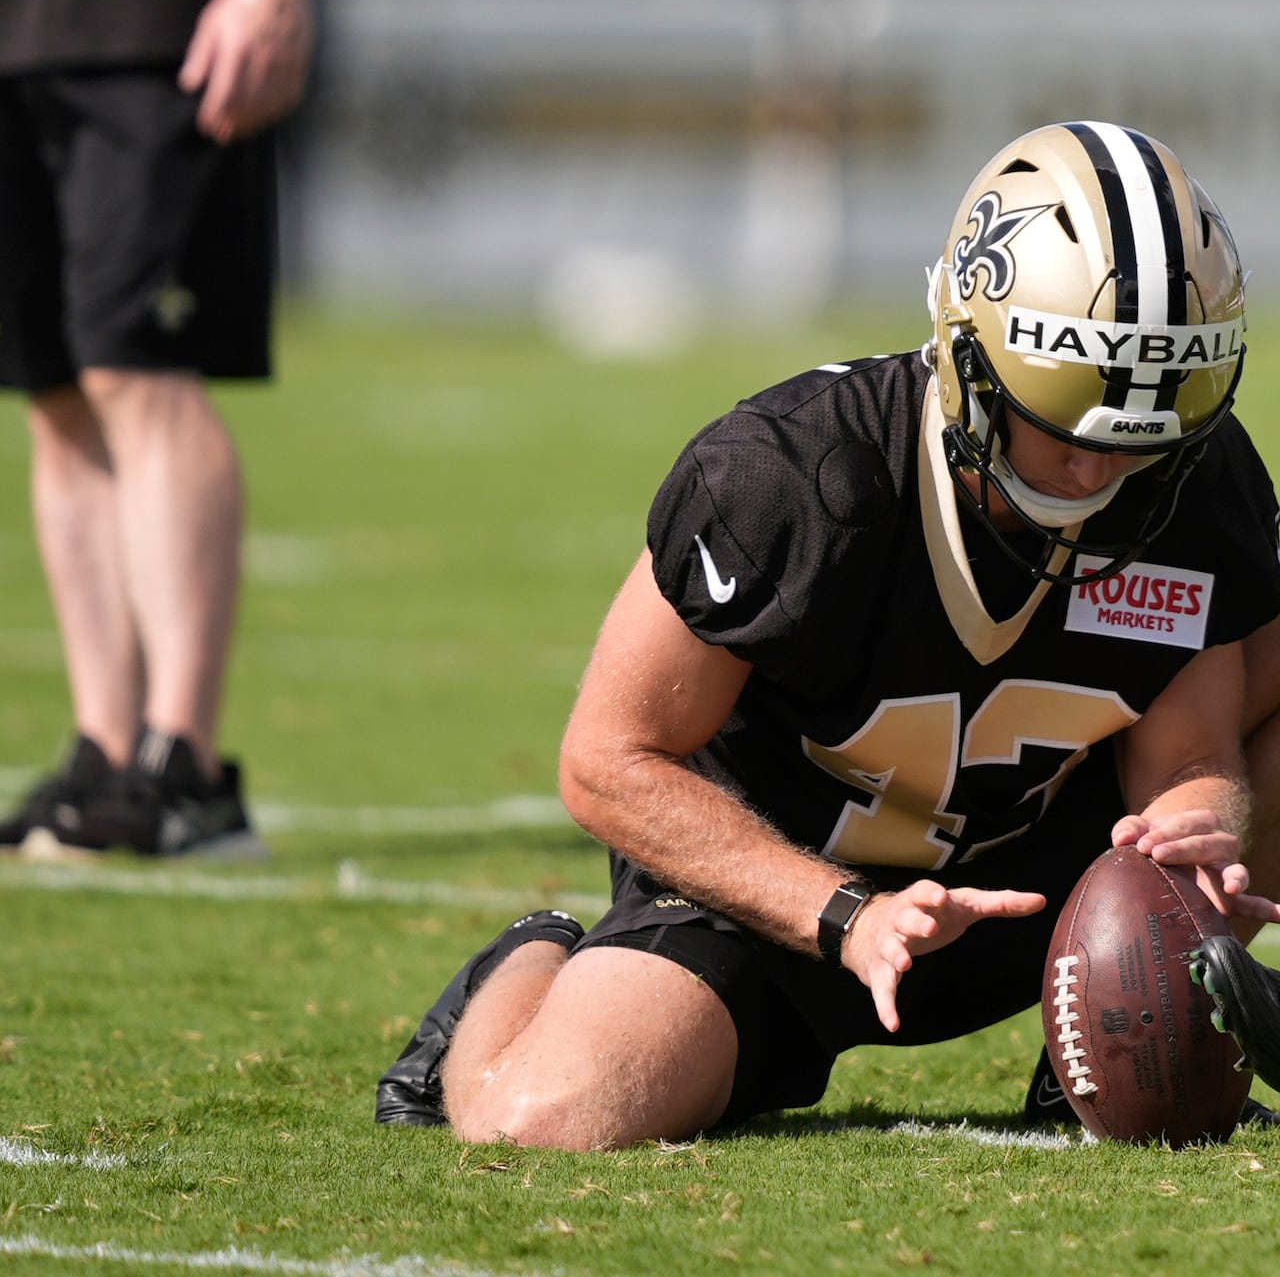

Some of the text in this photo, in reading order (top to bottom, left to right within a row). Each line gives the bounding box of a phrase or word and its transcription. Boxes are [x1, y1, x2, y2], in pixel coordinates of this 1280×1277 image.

[1009, 316, 1239, 364] HAYBALL
[1111, 420, 1165, 440] SAINTS
[1078, 567, 1203, 616] ROUSES
[1097, 607, 1175, 633] MARKETS
[1147, 913, 1165, 965] LEAGUE
